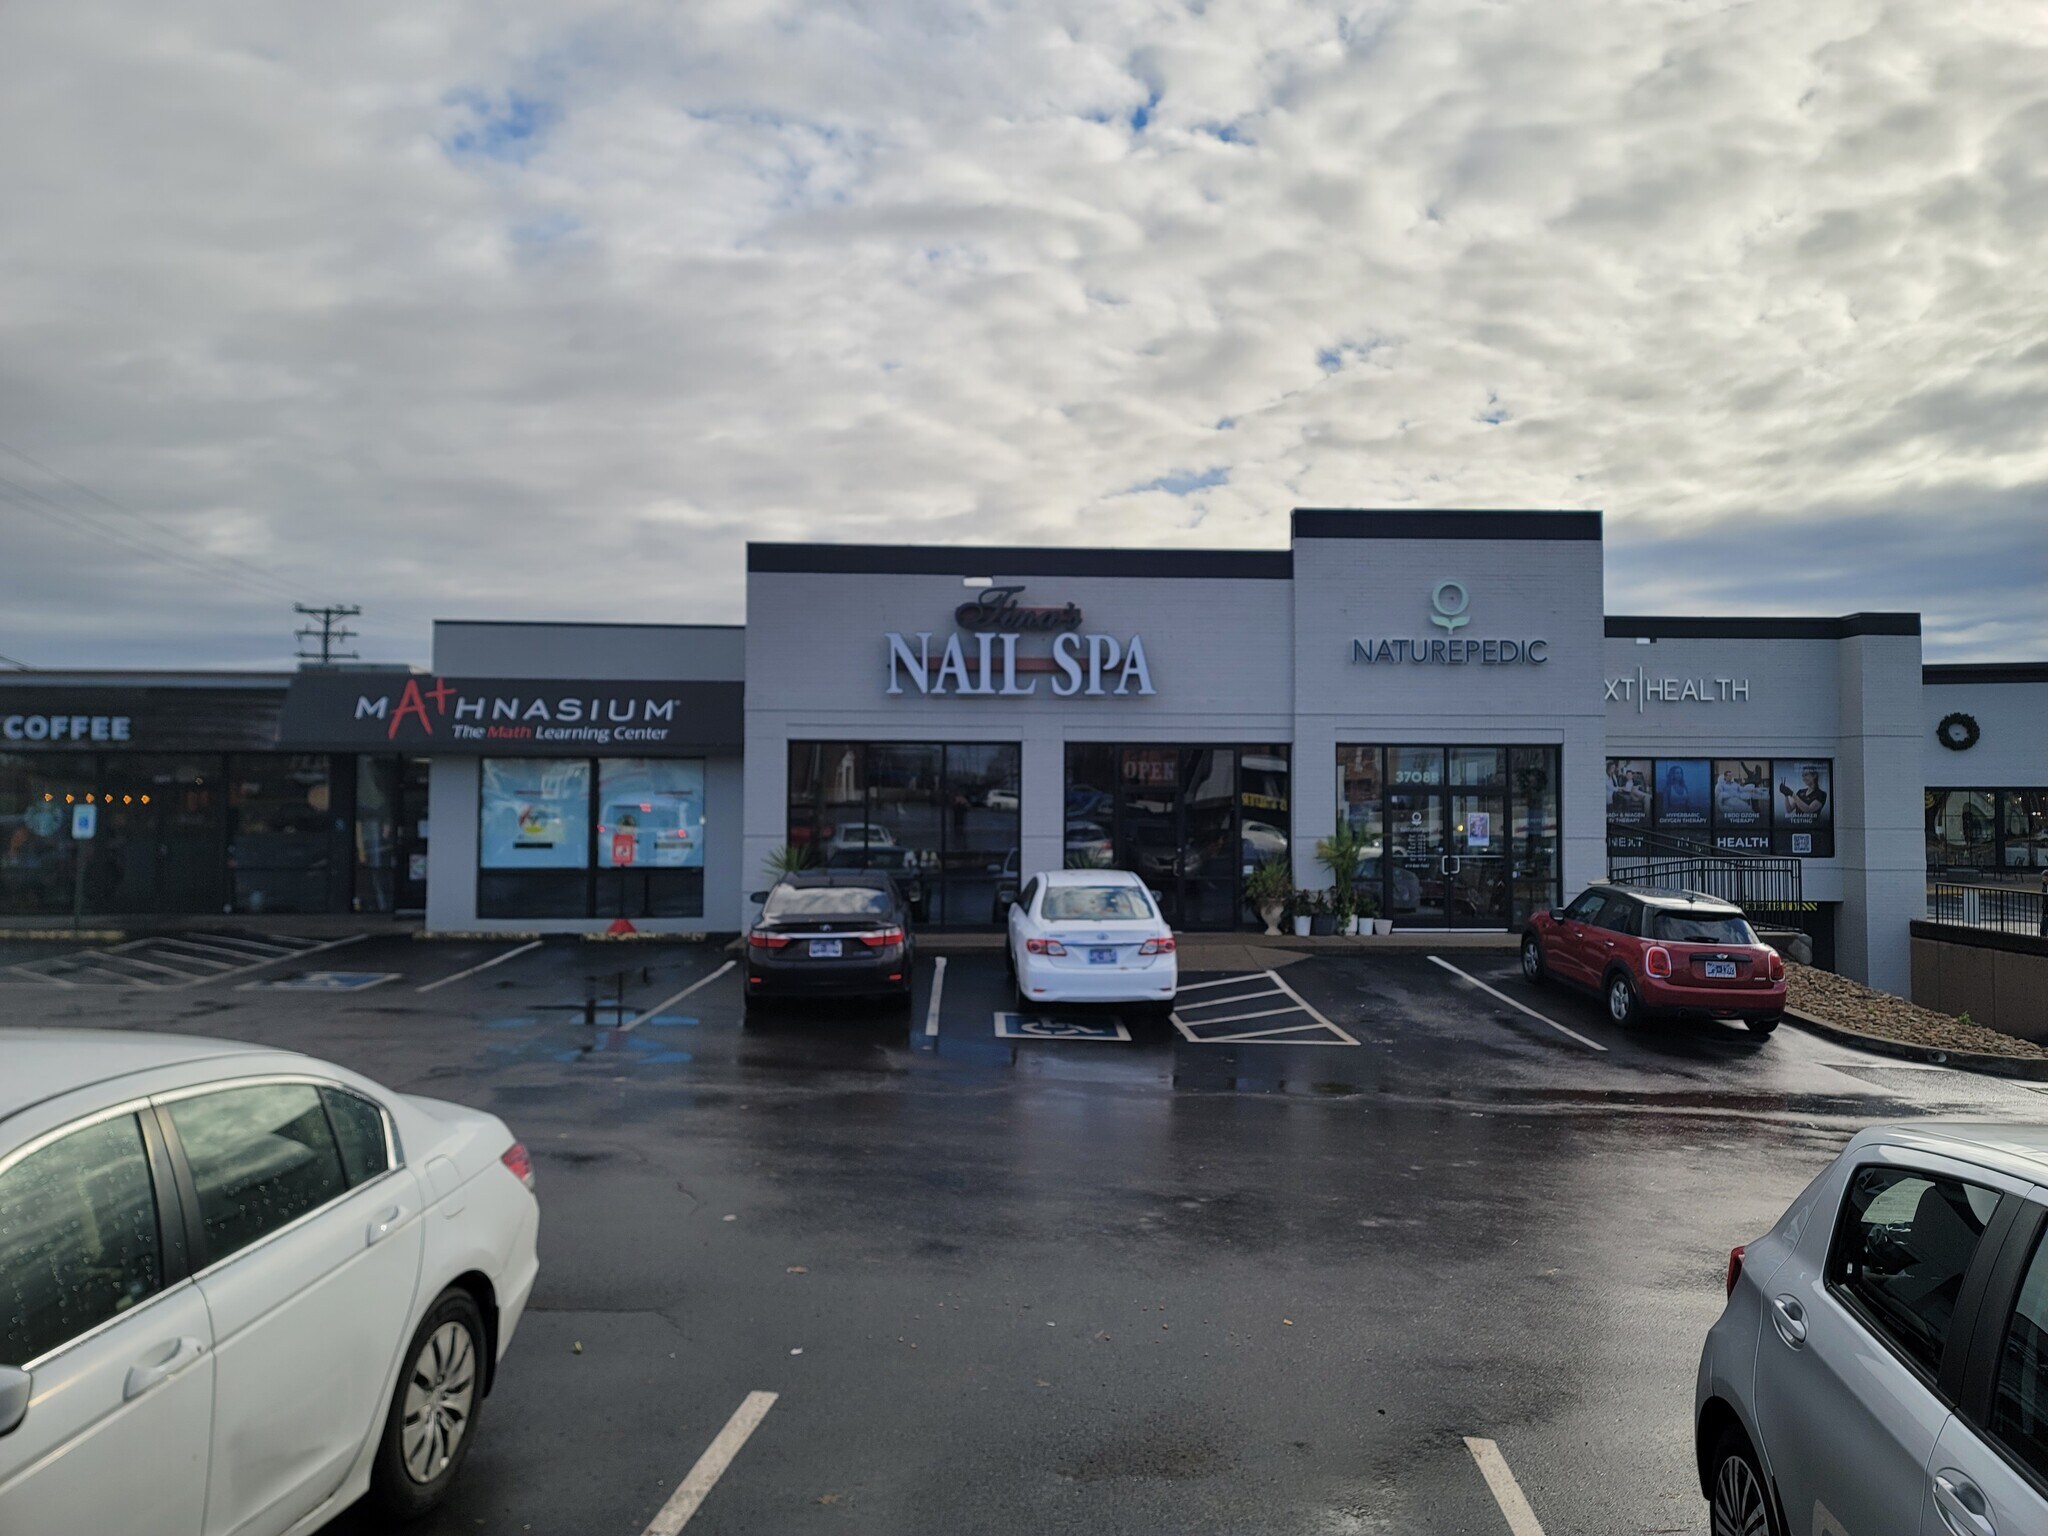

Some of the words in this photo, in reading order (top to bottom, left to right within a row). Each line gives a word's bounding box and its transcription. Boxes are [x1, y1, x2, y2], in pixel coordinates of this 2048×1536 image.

[1353, 639, 1548, 664] NATUREPEDIC
[885, 632, 1036, 694] NAIL
[1051, 632, 1157, 696] SPA
[1646, 679, 1749, 701] HEALTH
[3, 715, 131, 741] COFFEE
[453, 724, 485, 739] The
[487, 725, 531, 739] Math
[535, 726, 609, 743] Learning
[613, 726, 669, 741] Center
[1124, 761, 1175, 780] OPEN
[1608, 836, 1644, 847] NEXT
[1717, 837, 1769, 848] HEALTH
